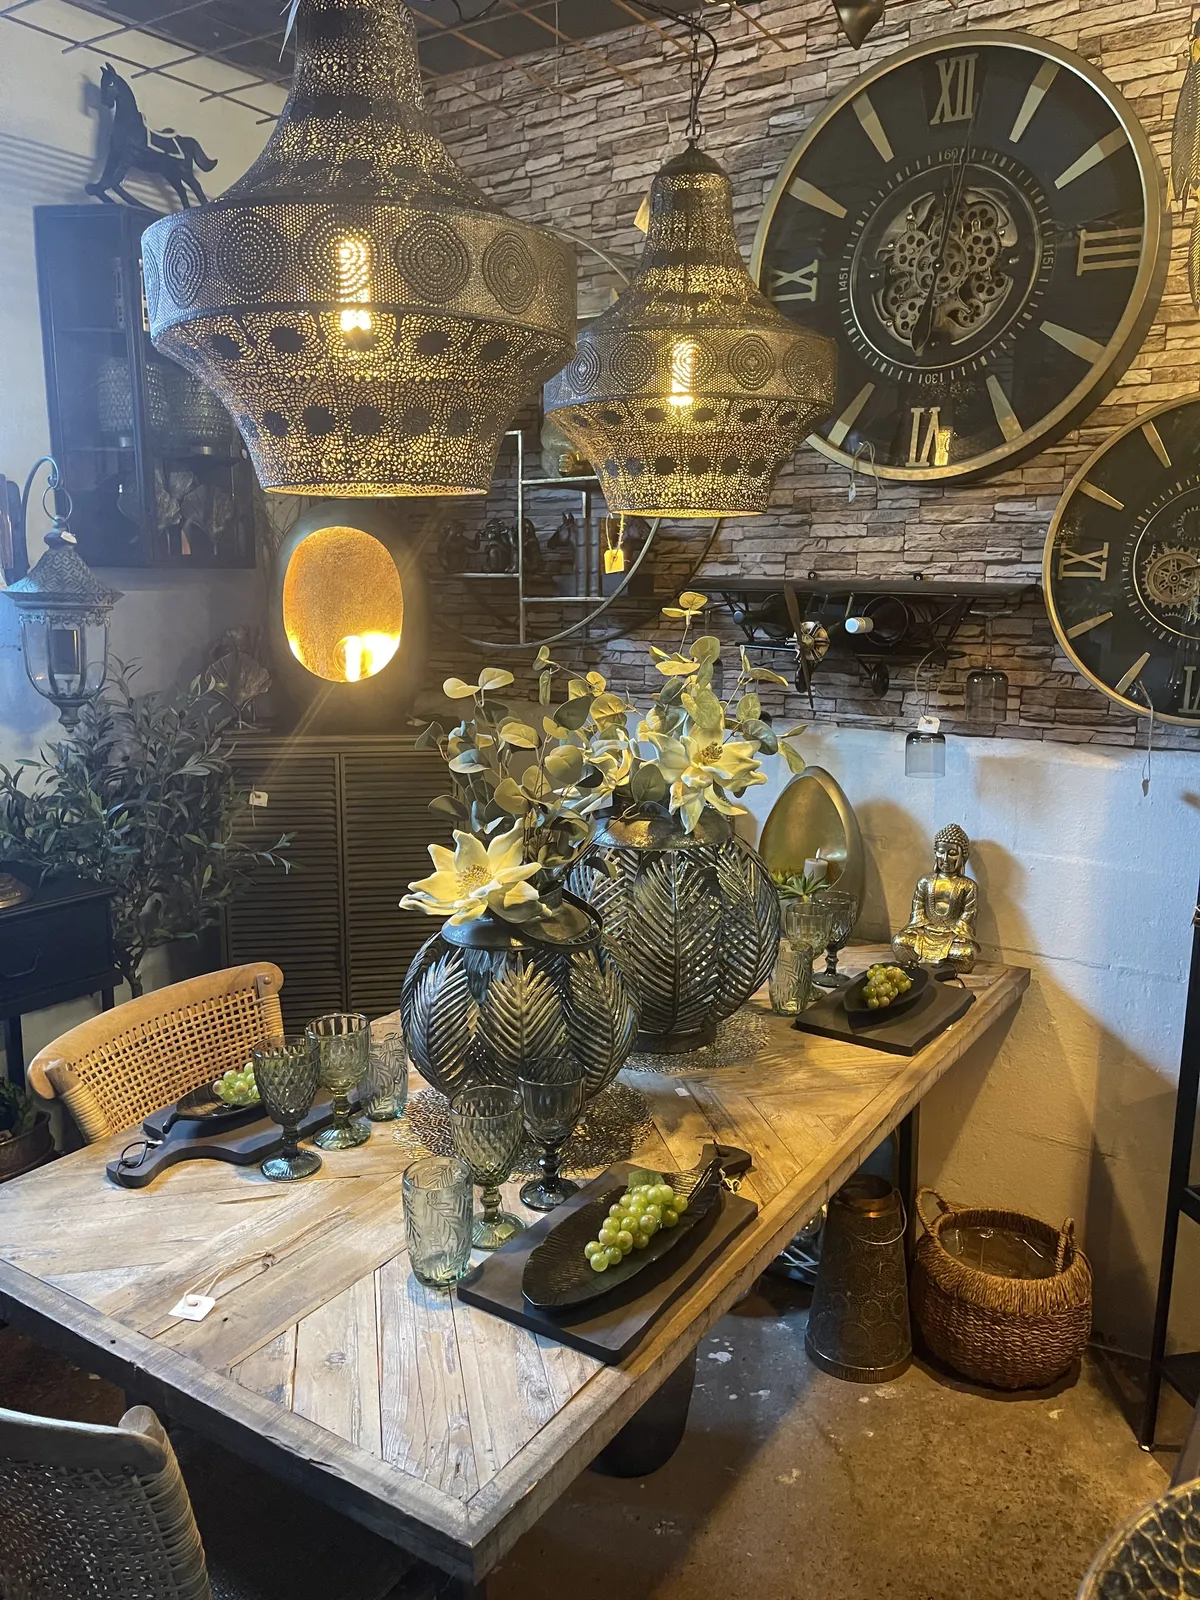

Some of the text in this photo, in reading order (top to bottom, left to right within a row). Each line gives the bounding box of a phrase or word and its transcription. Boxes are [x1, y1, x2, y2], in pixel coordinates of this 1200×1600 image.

[929, 53, 979, 125] XII
[1076, 227, 1144, 277] III
[924, 373, 939, 385] 30
[1058, 542, 1109, 581] IX
